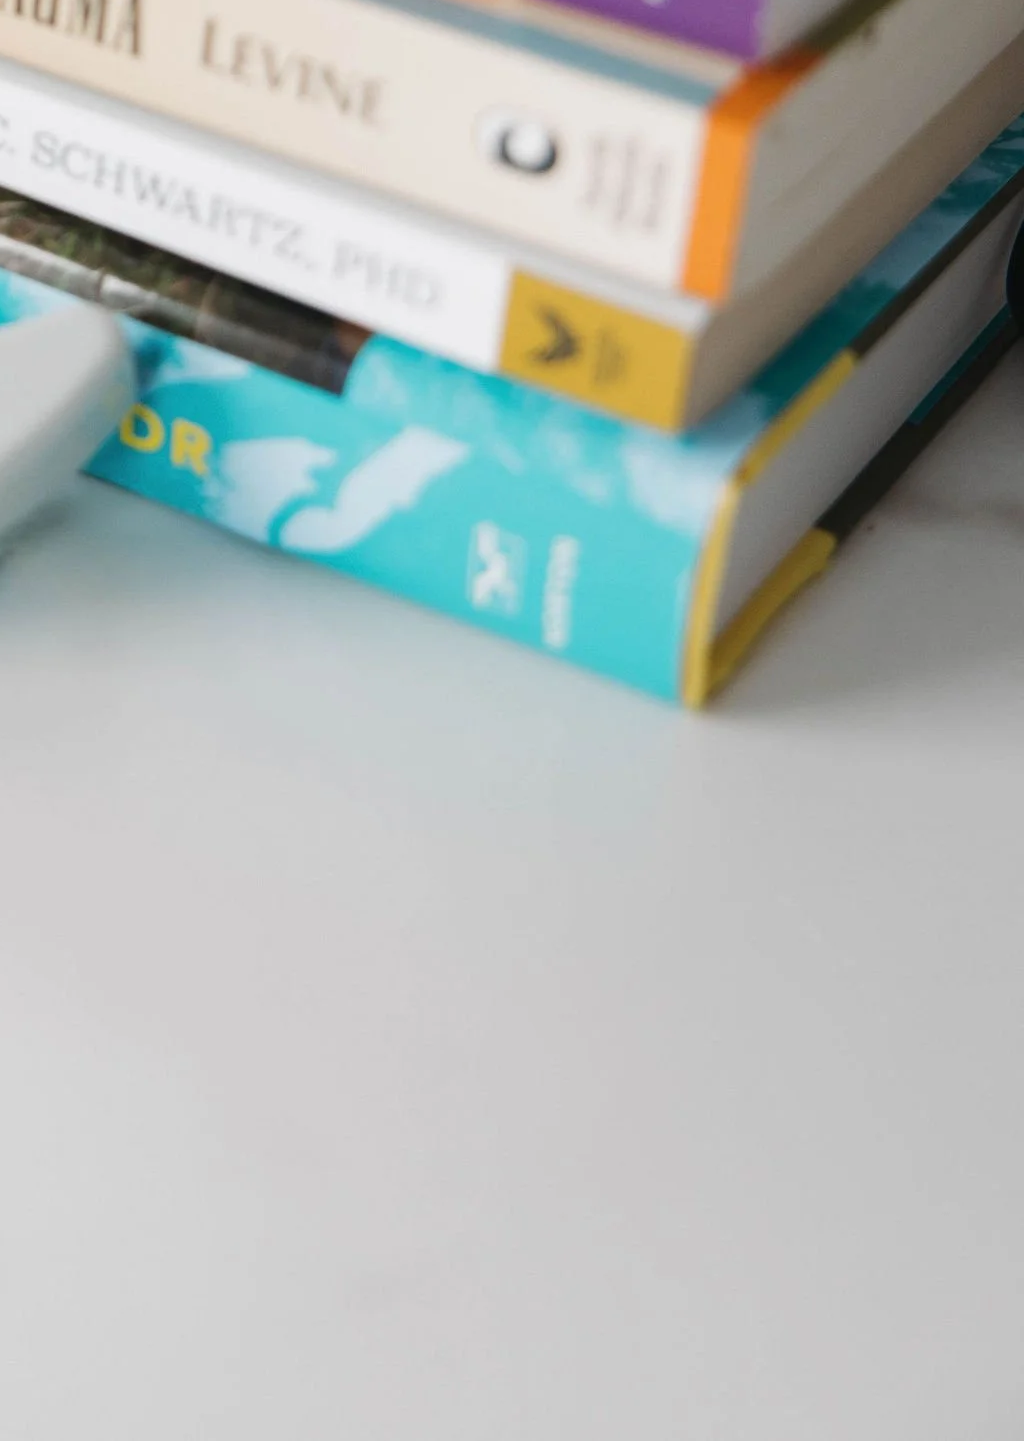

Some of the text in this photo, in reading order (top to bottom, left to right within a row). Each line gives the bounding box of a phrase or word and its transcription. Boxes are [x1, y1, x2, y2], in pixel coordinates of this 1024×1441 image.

[199, 16, 384, 125] LEVINE
[28, 128, 318, 273] SCHWARTZ,
[331, 233, 446, 313] PHD
[118, 400, 213, 476] DR
